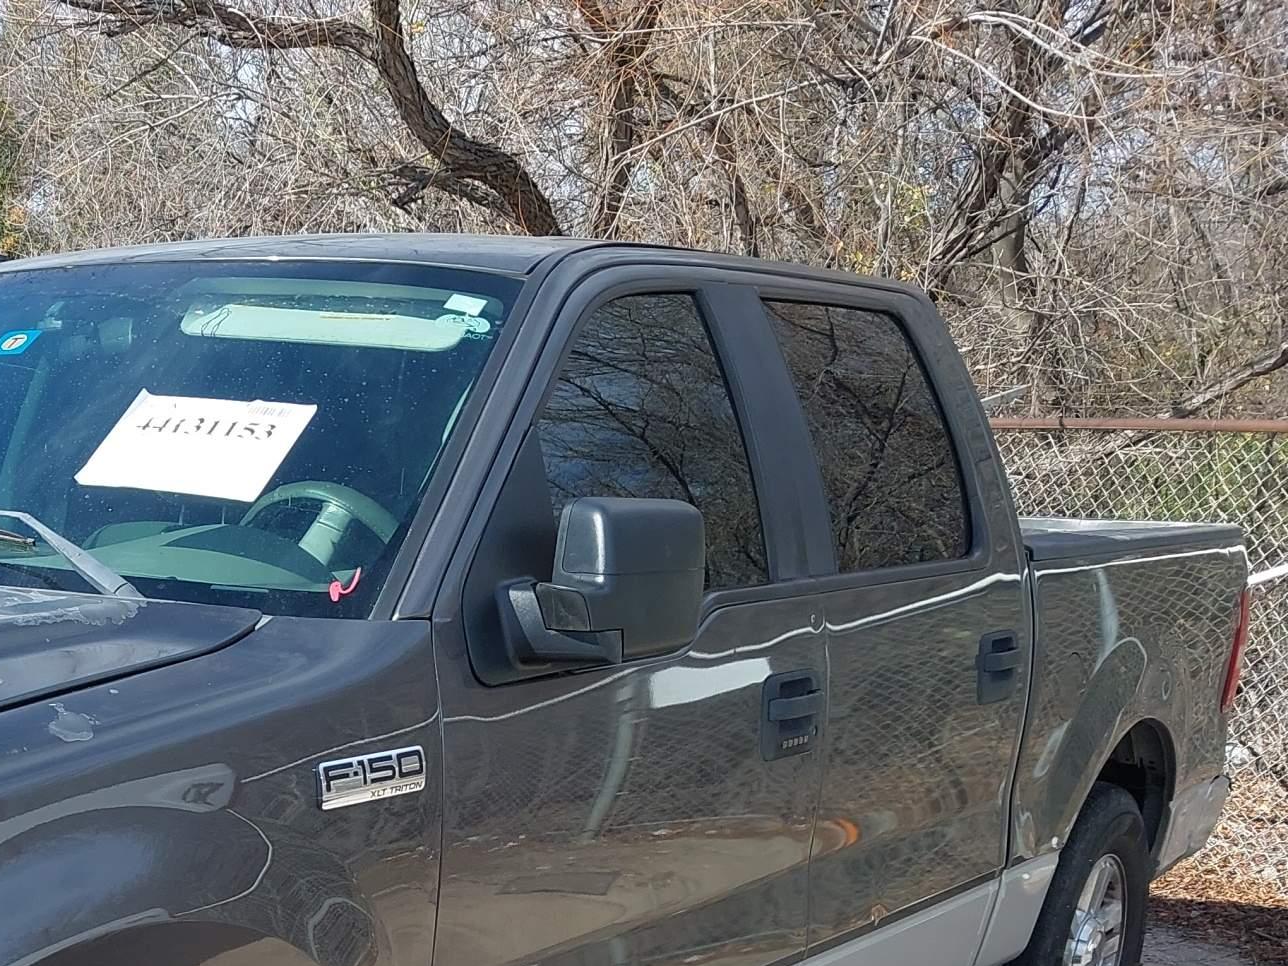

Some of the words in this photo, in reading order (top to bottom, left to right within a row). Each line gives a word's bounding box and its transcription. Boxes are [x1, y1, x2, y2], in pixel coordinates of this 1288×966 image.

[135, 416, 278, 441] 44131153
[321, 747, 425, 793] F-150
[369, 787, 388, 799] XLT
[388, 780, 424, 795] TRITON
